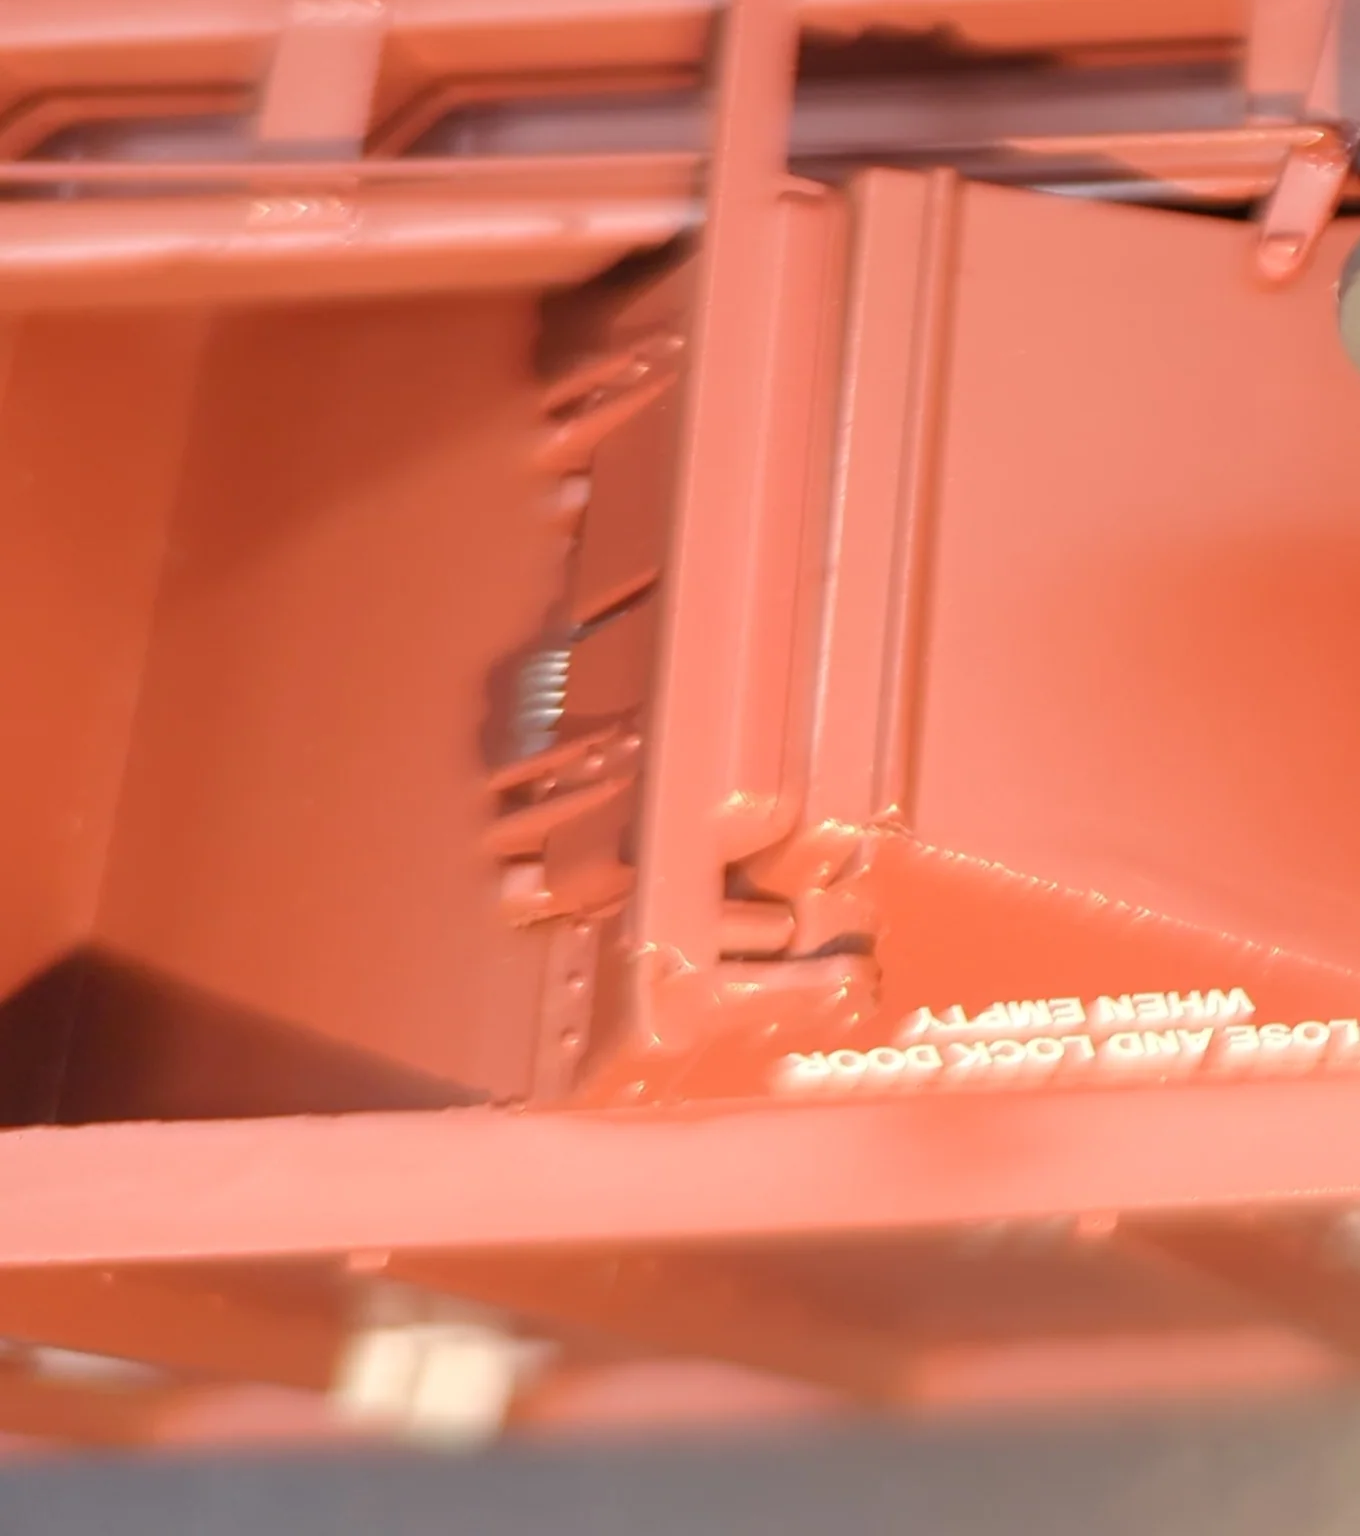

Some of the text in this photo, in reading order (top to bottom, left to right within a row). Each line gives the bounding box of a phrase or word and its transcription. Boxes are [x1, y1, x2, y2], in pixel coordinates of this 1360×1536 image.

[910, 987, 1256, 1033] WHEN EMPTY
[953, 1034, 1095, 1066] LOCK
[1108, 1026, 1214, 1058] AND
[789, 1044, 943, 1077] DOOR
